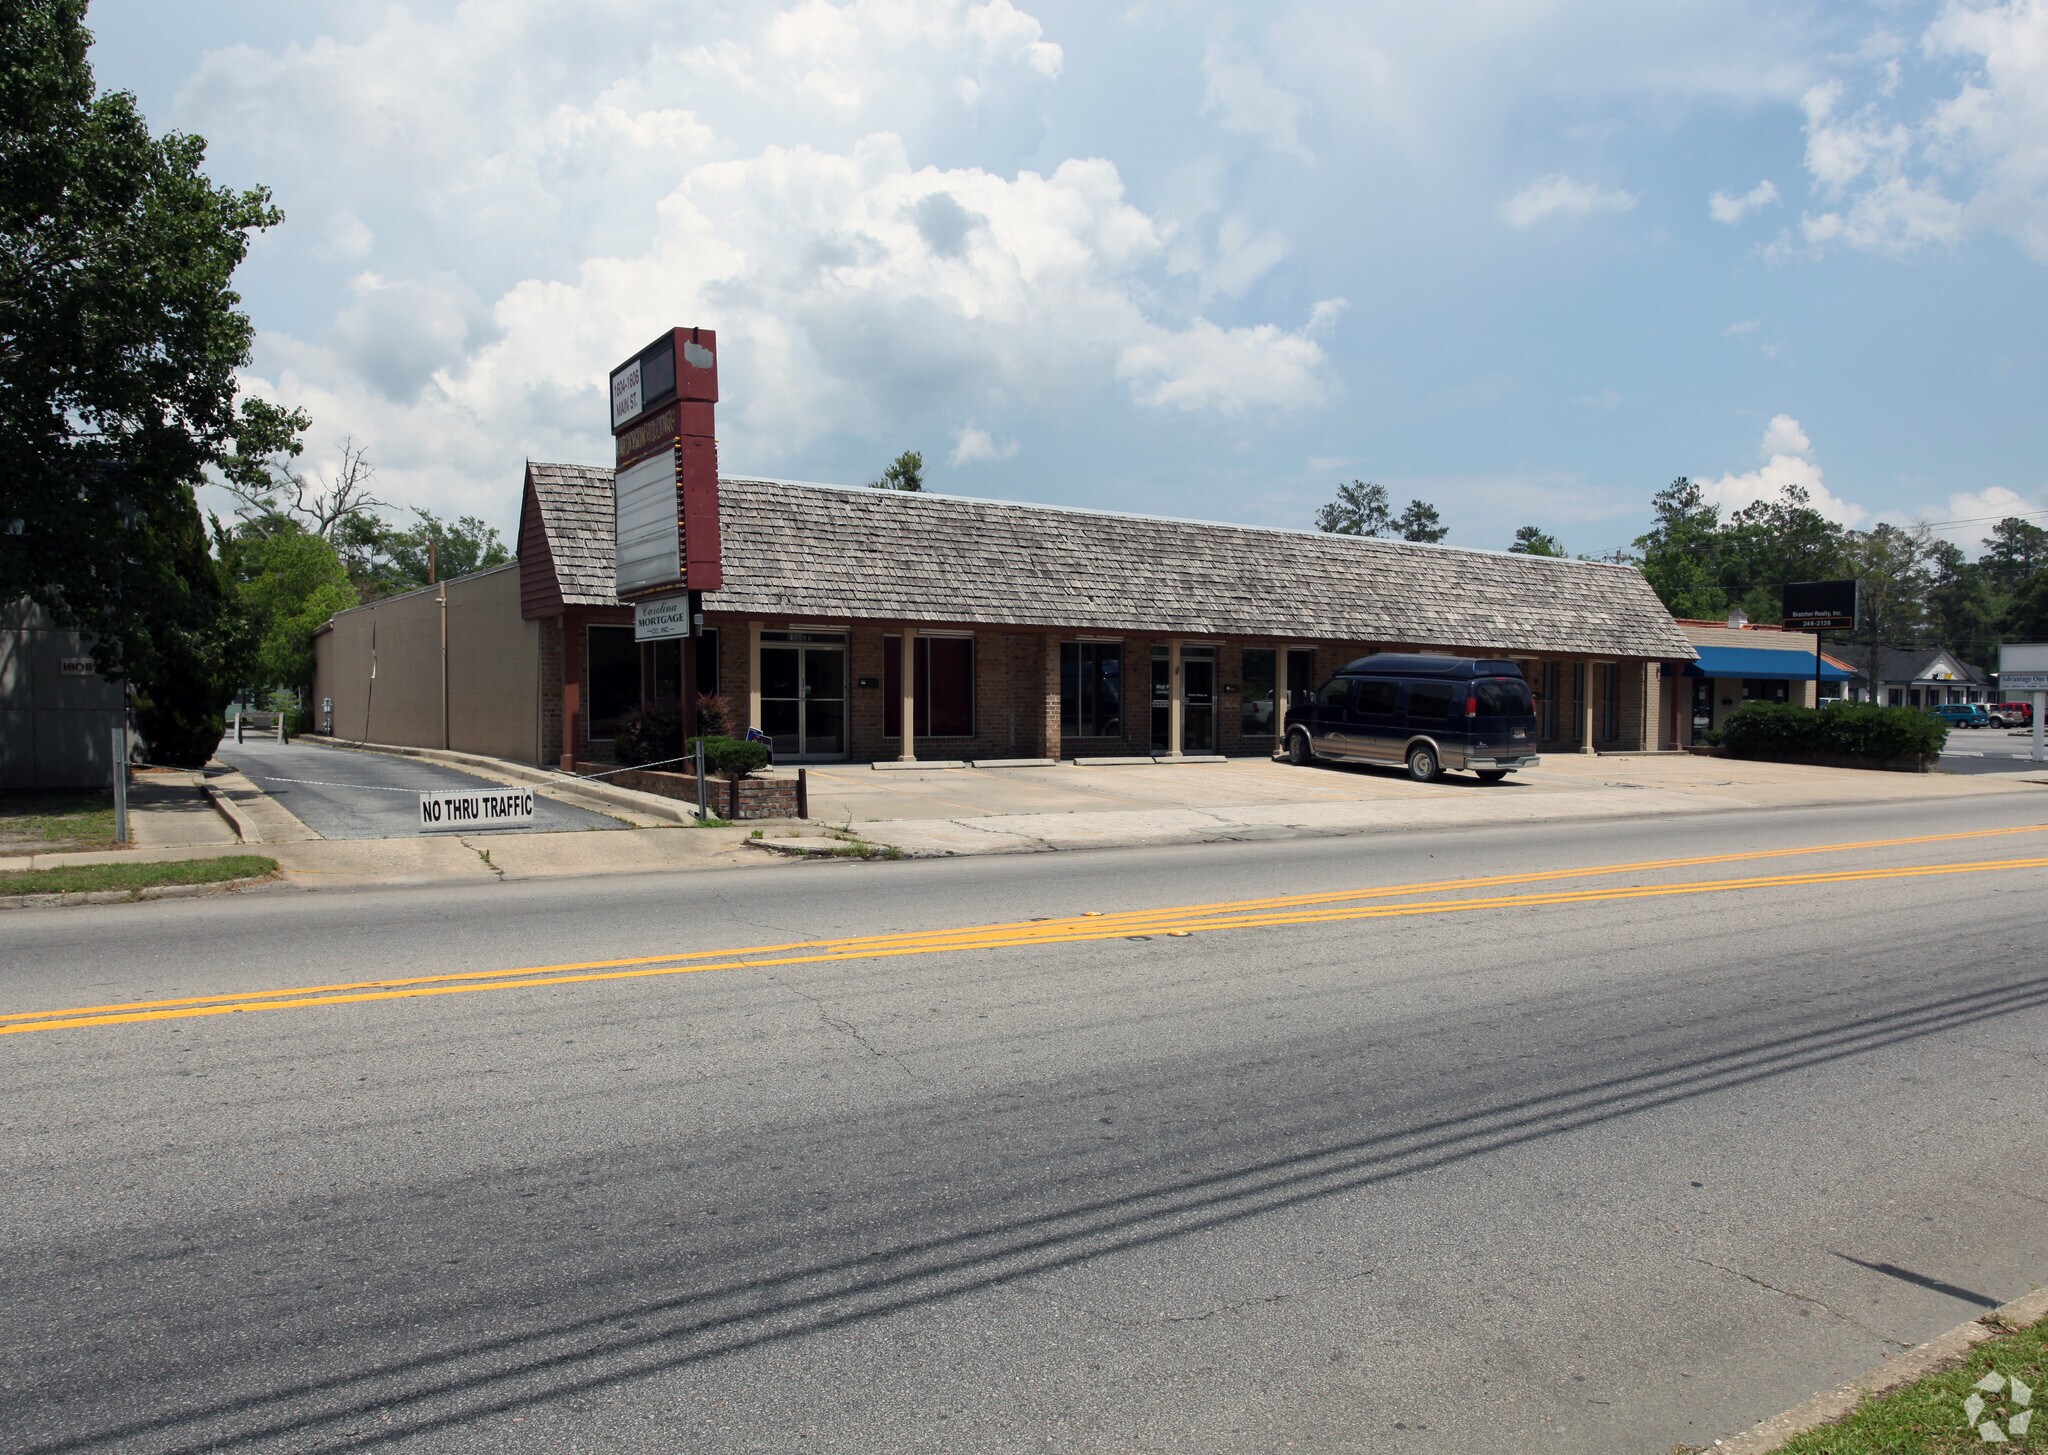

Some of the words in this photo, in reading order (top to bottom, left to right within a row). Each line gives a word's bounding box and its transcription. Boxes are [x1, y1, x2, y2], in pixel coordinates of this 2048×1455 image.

[616, 396, 630, 418] MAIN
[641, 601, 677, 616] Carolina
[638, 613, 685, 628] MORTGAGE
[63, 662, 93, 671] 1608
[422, 799, 442, 823] NO
[444, 798, 479, 821] THRU
[482, 794, 533, 818] TRAFFIC
